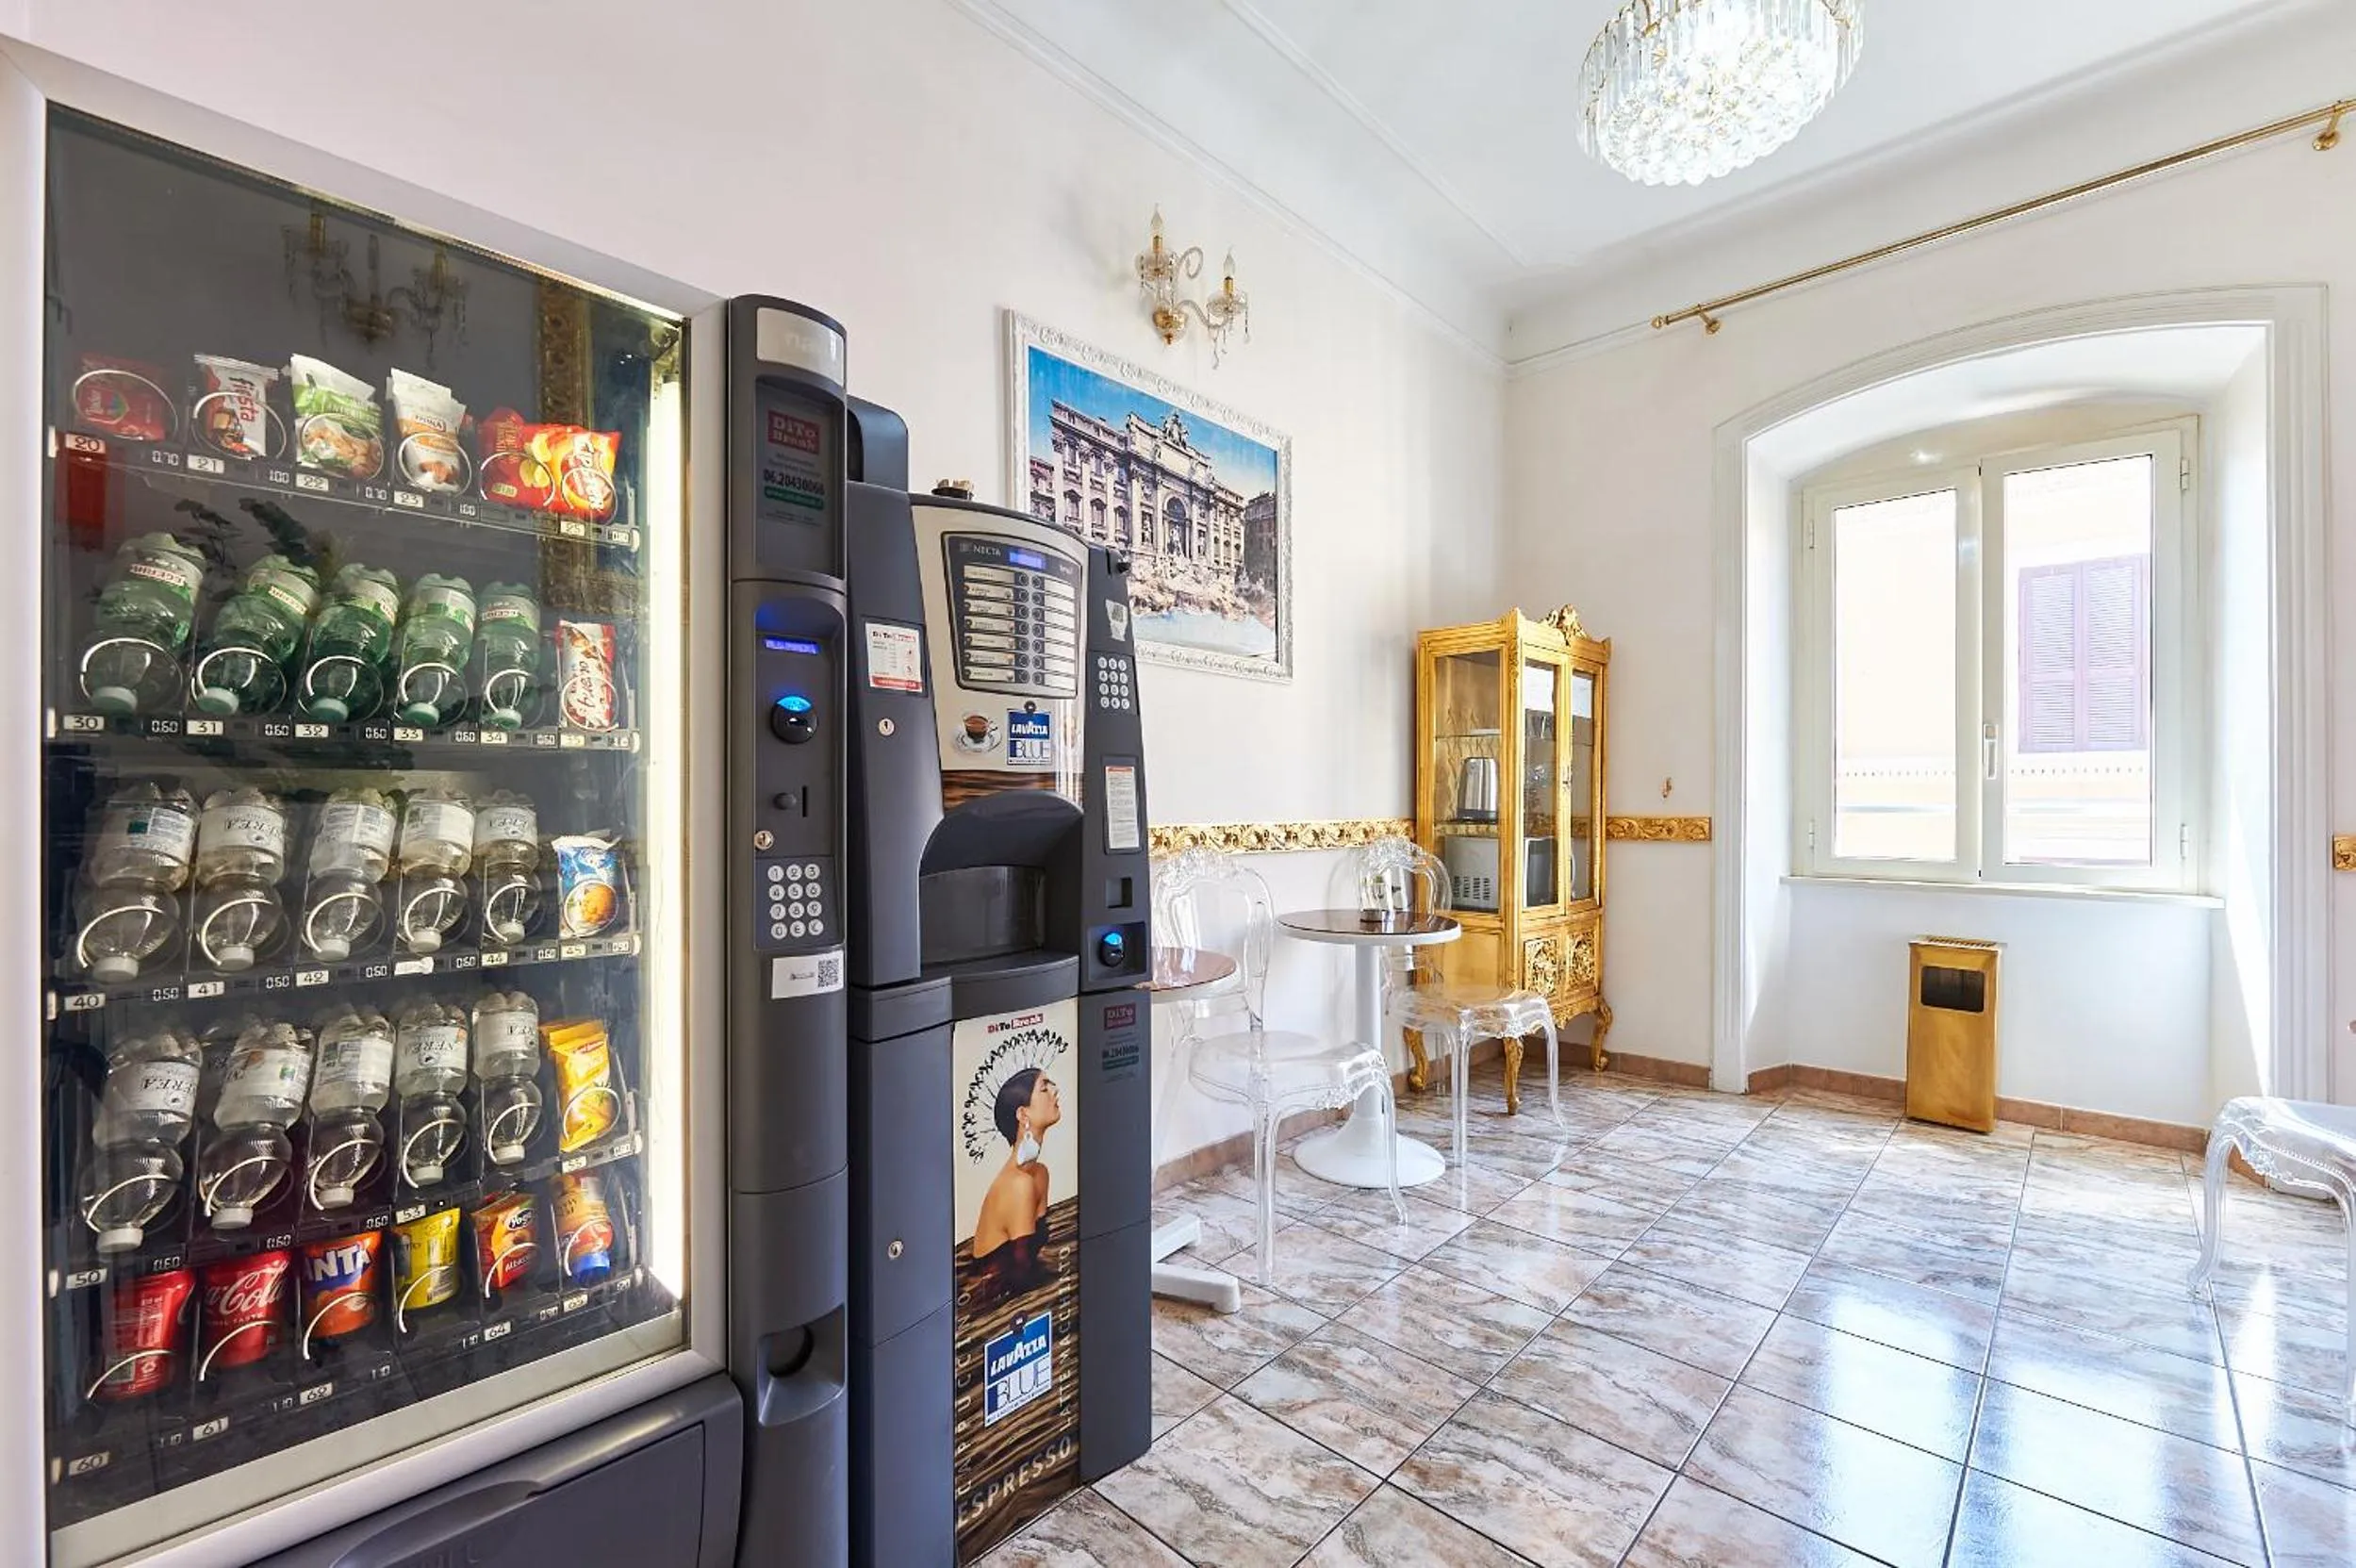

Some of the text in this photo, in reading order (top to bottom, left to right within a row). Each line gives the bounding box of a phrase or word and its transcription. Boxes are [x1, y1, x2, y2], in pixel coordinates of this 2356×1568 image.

[75, 437, 100, 451] 20
[197, 456, 216, 472] 21
[304, 475, 323, 488] 22
[402, 493, 419, 505] 23
[74, 717, 98, 730] 30
[197, 720, 216, 733] 31
[303, 724, 322, 736] 32
[401, 728, 419, 740] 33
[486, 733, 503, 743] 34
[305, 972, 323, 983] 42
[198, 983, 217, 995] 41
[74, 995, 99, 1009] 40
[404, 1206, 420, 1220] 53
[75, 1270, 101, 1287] 50
[489, 1324, 506, 1339] 64
[991, 1334, 1047, 1377] LAVAZZA
[307, 1386, 327, 1401] 62
[203, 1420, 222, 1436] 61
[77, 1454, 104, 1472] 60
[956, 1435, 1072, 1528] ESPRESSO
